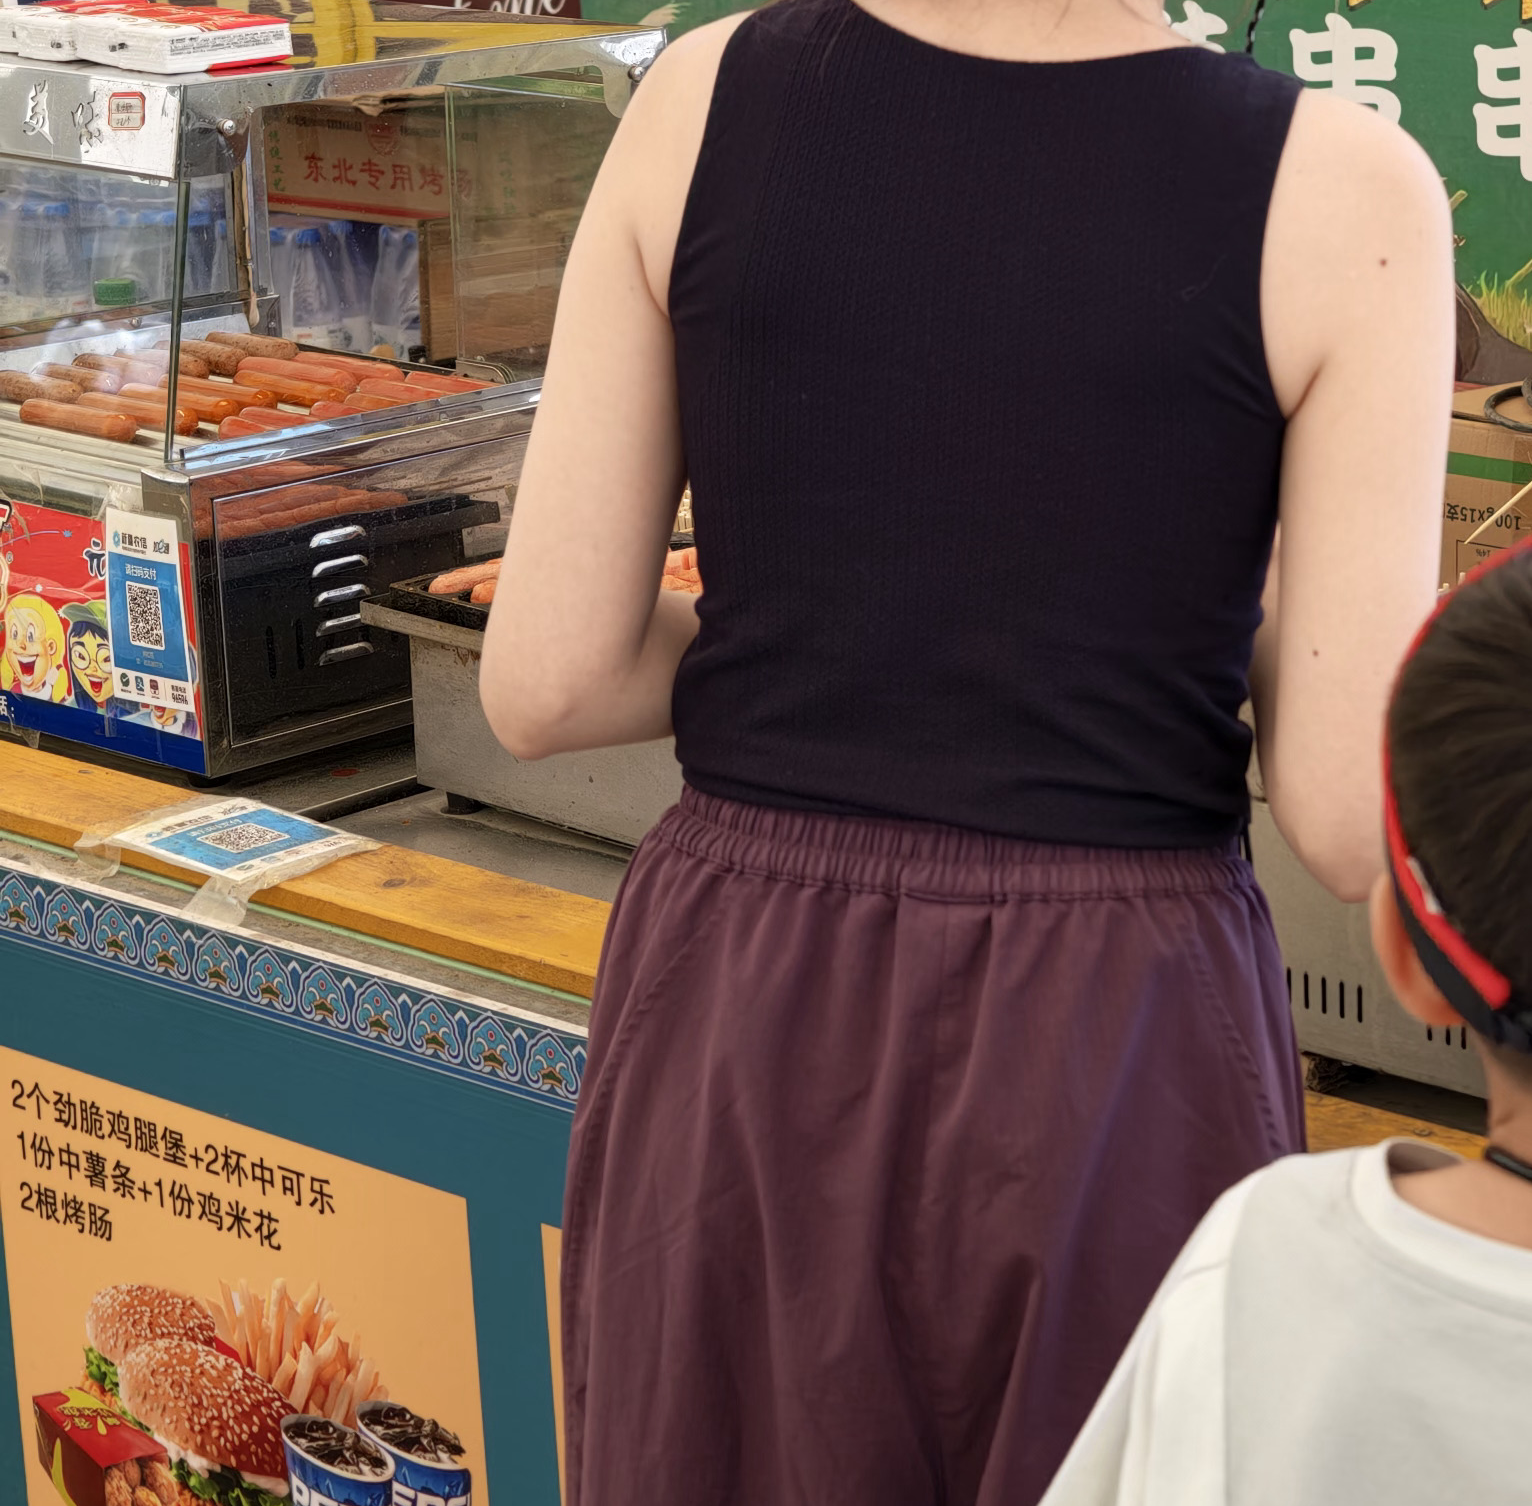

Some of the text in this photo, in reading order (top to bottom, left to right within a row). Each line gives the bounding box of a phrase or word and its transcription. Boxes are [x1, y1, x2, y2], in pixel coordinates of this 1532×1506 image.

[11, 1079, 337, 1215] 2个劲脆鸡腿堡+2杯中可乐
[17, 1132, 282, 1251] 1份中薯条+1份鸡米花
[19, 1182, 113, 1242] 2根烤肠
